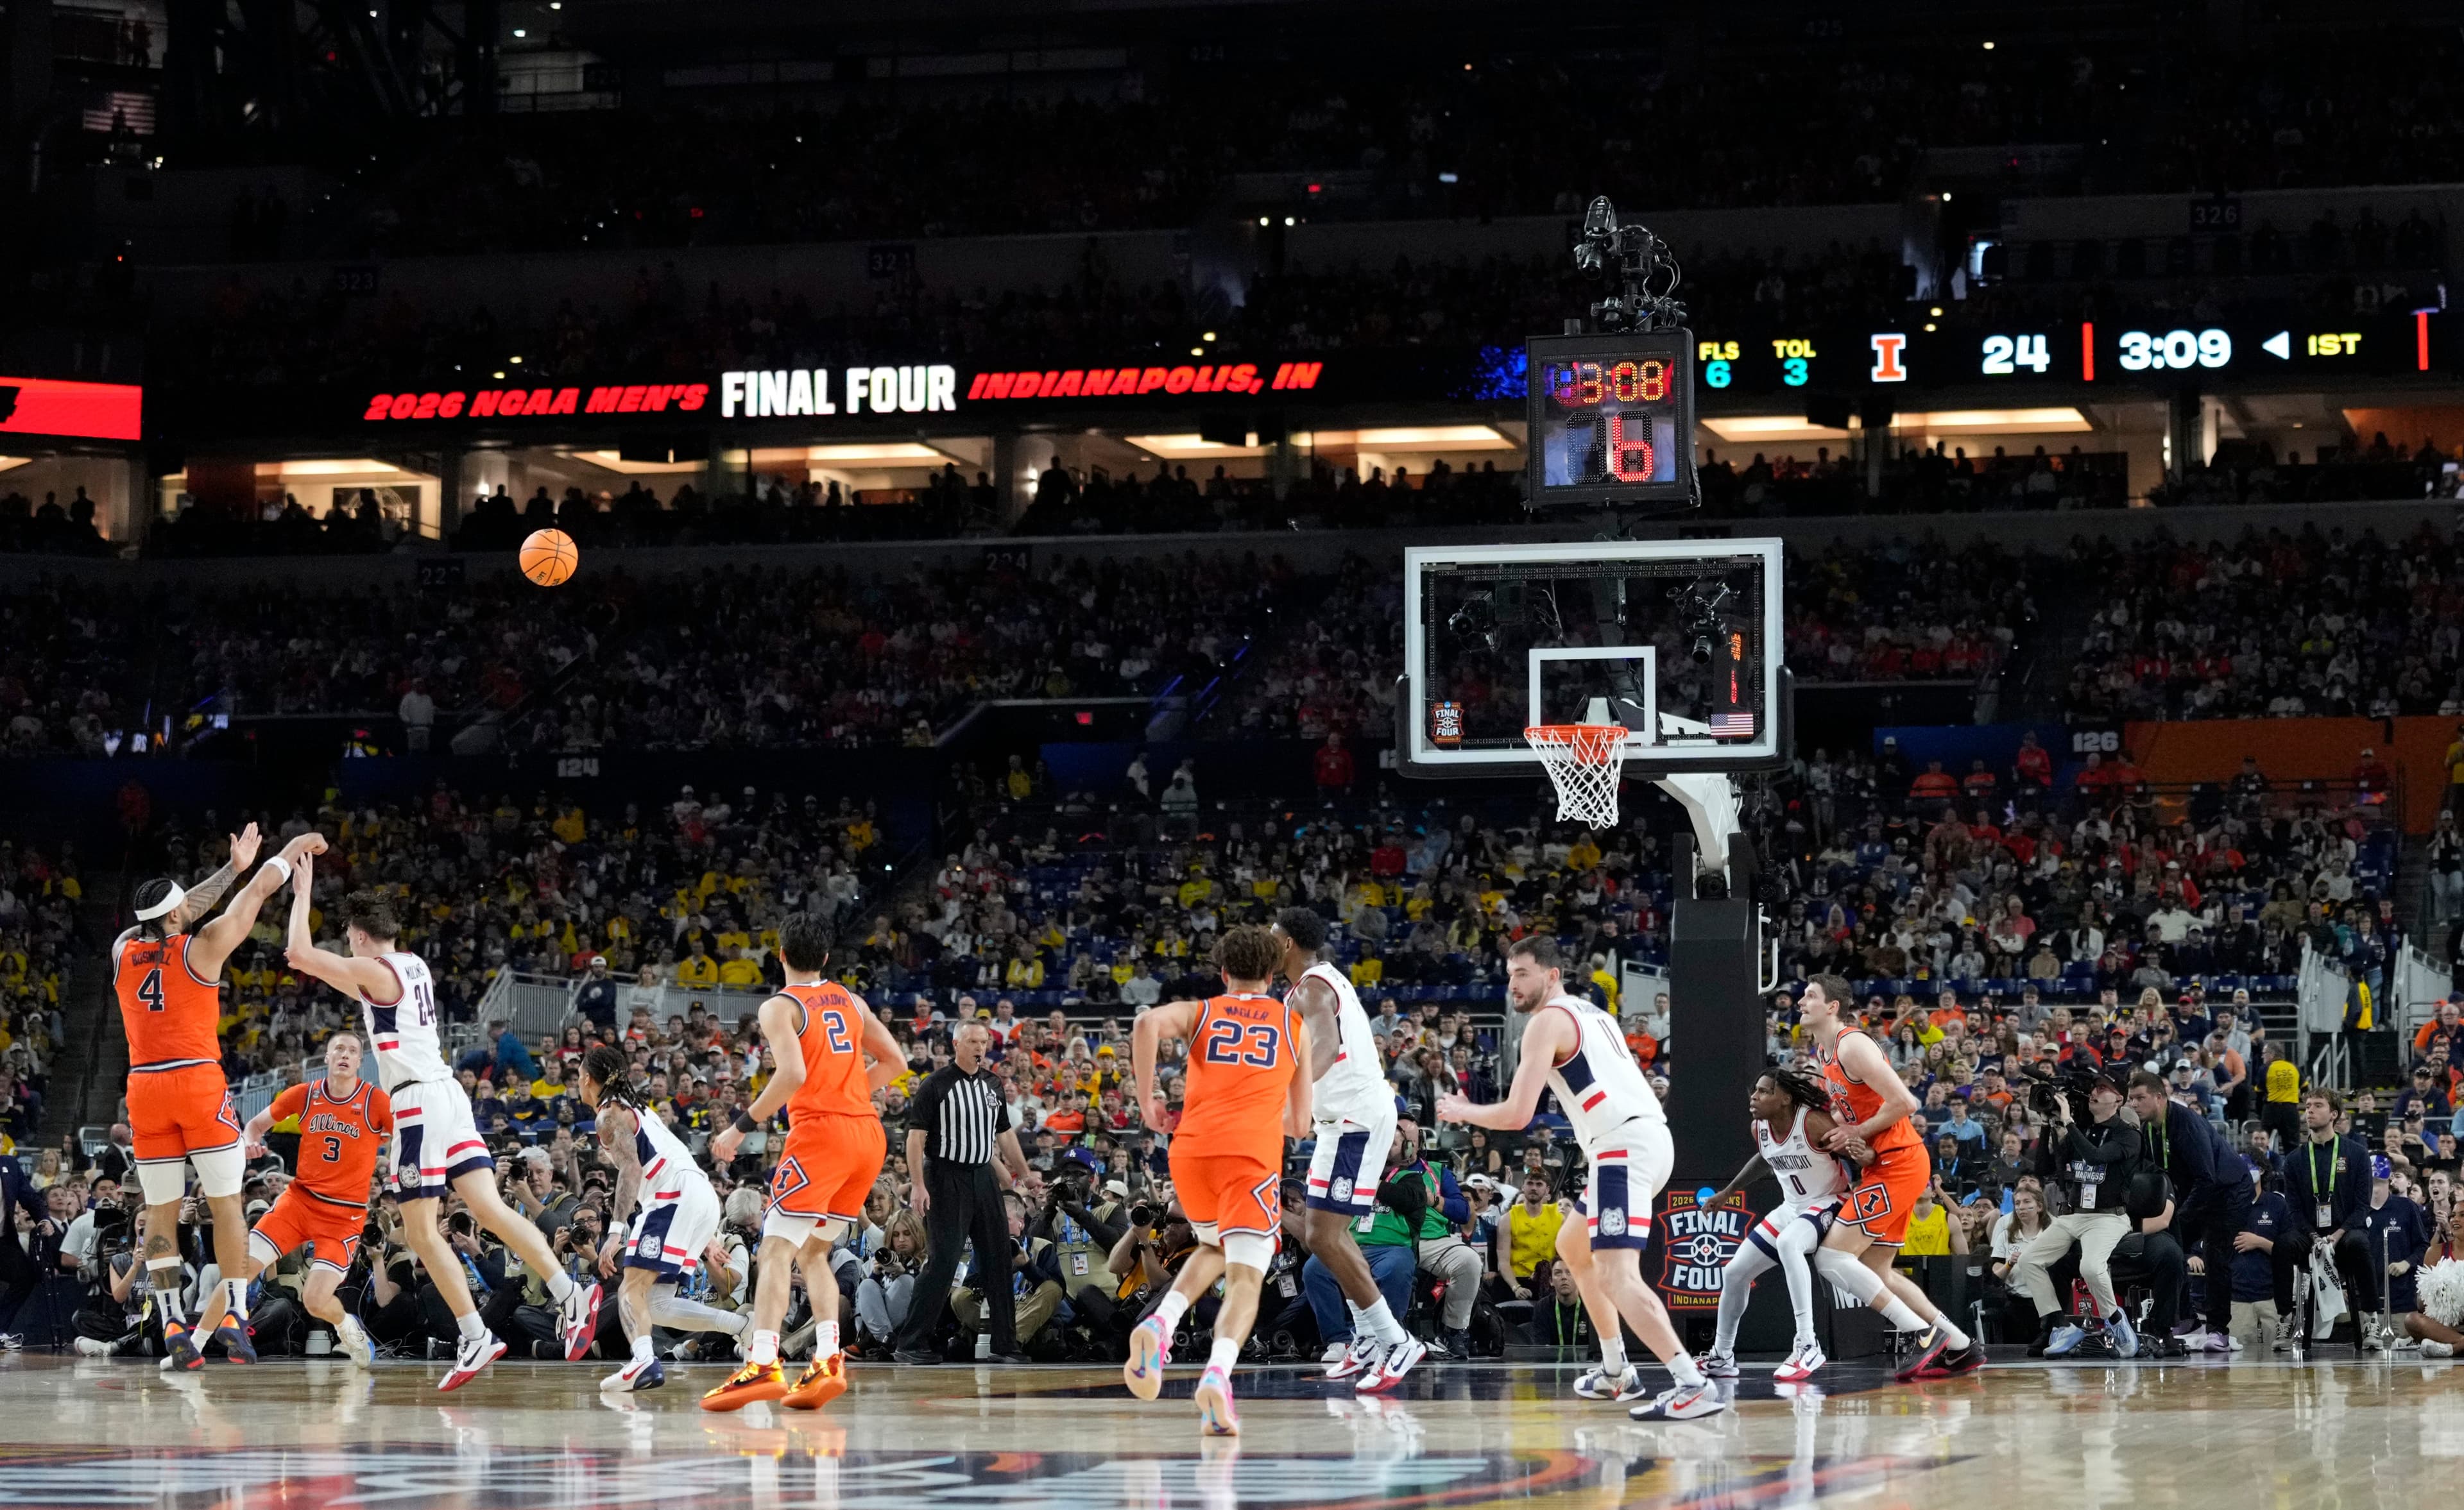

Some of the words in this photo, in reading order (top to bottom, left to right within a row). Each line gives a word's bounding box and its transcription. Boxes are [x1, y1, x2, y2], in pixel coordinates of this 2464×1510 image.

[2194, 205, 2238, 225] 326
[338, 272, 375, 291] 323
[1698, 341, 1740, 361] FLS
[1772, 339, 1817, 359] TOL
[1871, 334, 1906, 382] I
[1982, 334, 2050, 375] 24
[2119, 328, 2232, 370] 3:09
[1582, 361, 1664, 404] 3:08
[1706, 359, 1731, 388] 6
[1784, 358, 1808, 386] 3
[364, 391, 466, 420] 2026
[469, 387, 580, 417] NCAA
[585, 384, 709, 413] MEN'S
[722, 369, 836, 418] FINAL
[846, 364, 956, 414] FOUR
[968, 364, 1264, 400] INDIANAPOLIS,
[1271, 362, 1323, 390] IN
[1612, 416, 1654, 482] 6
[1435, 709, 1459, 719] FINAL
[1436, 727, 1459, 736] FOUR
[2073, 731, 2119, 752] 126
[557, 758, 600, 777] 124
[132, 951, 172, 968] BOSWLL
[136, 969, 165, 1012] 4
[414, 981, 435, 1027] 24
[1223, 1006, 1270, 1022] WAGLER
[821, 1010, 854, 1055] 2
[1206, 1019, 1280, 1070] 23
[1835, 1098, 1857, 1123] 13
[309, 1113, 360, 1139] Illinois
[323, 1135, 341, 1163] 3
[1790, 1175, 1808, 1196] 0
[2075, 1171, 2105, 1182] MADNESS
[1672, 1196, 1694, 1207] 2026
[1670, 1210, 1740, 1237] FINAL
[1672, 1264, 1726, 1291] FOU
